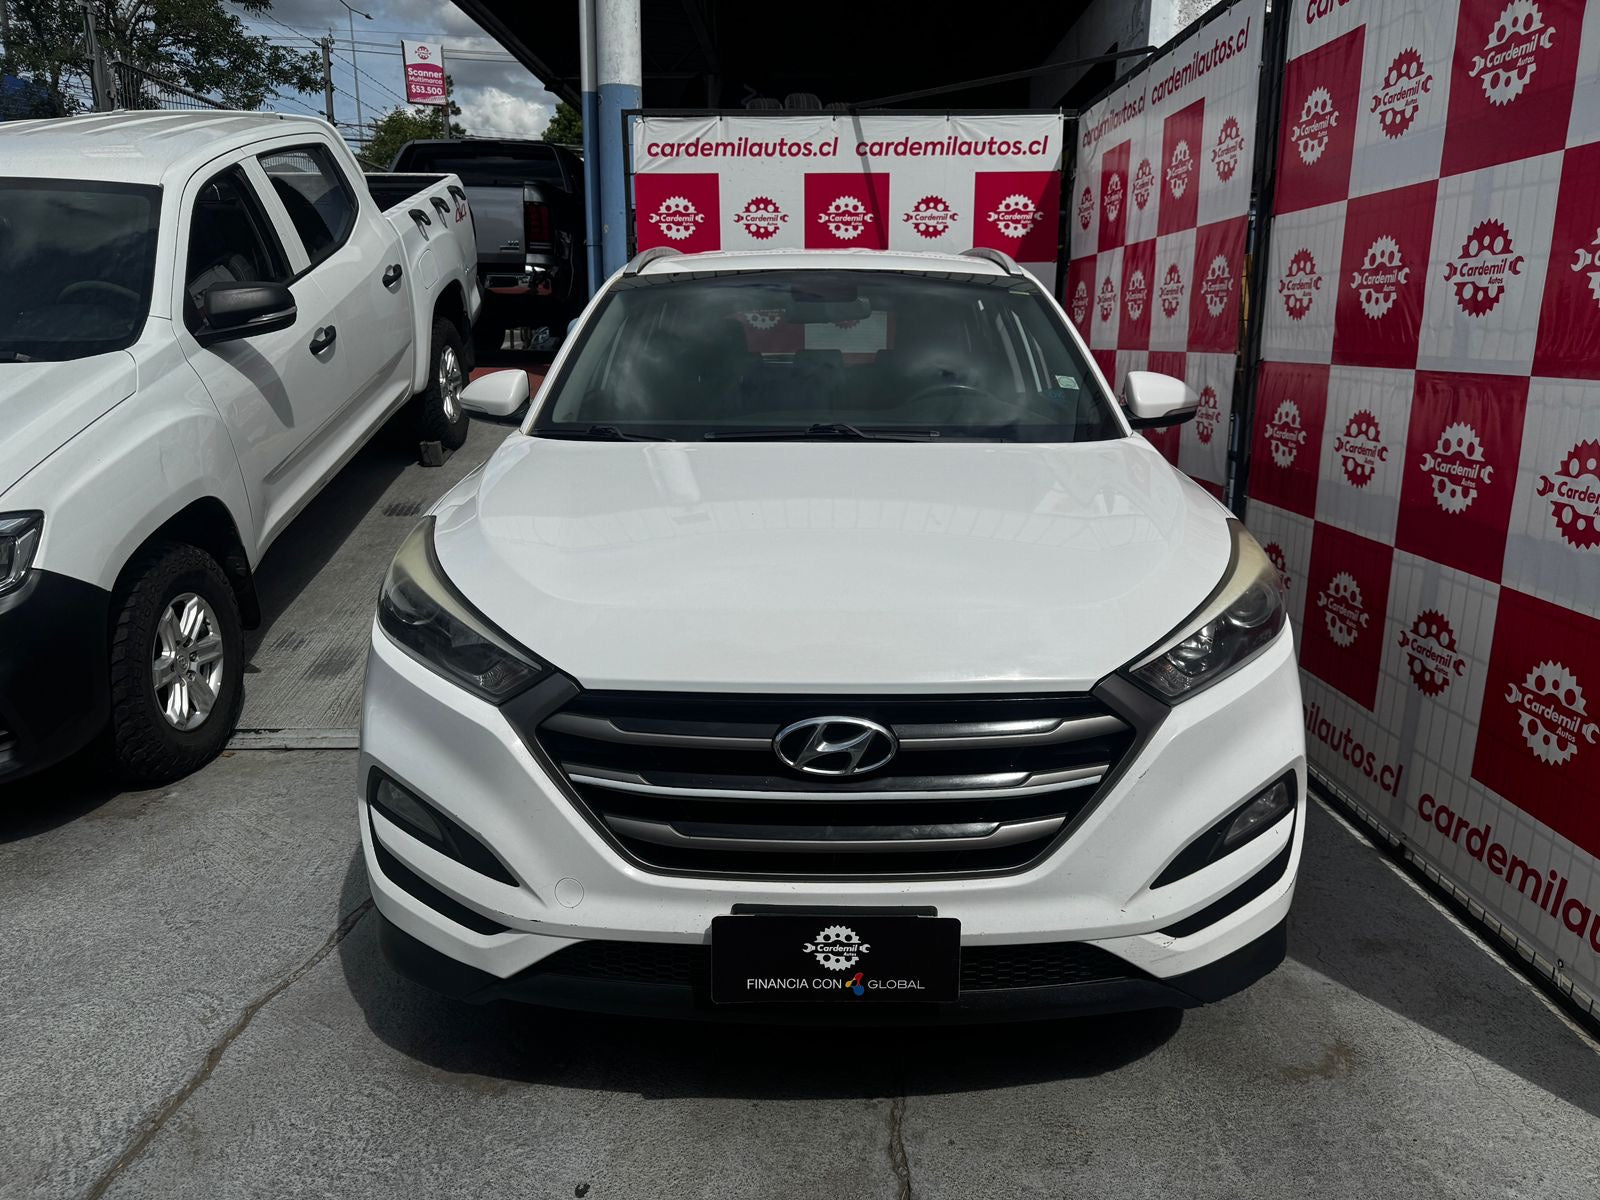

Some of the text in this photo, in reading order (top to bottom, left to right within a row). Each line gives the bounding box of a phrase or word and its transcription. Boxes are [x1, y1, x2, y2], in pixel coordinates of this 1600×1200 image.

[1486, 33, 1539, 68] Cardemil
[1151, 16, 1251, 105] cardemilautos.cl
[1516, 55, 1535, 67] Autos
[408, 68, 442, 78] Scanner
[411, 84, 443, 95] $53.500
[1383, 80, 1420, 106] Cardemil
[1300, 115, 1330, 136] Cardemil
[647, 135, 1049, 158] cardemilautos.cl cardemilautos.cl
[660, 213, 695, 222] Cardemil
[745, 213, 779, 222] Cardemil
[829, 213, 863, 222] Cardemil
[914, 213, 949, 221] Cardemil
[999, 211, 1034, 220] Cardemil
[1459, 257, 1508, 278] Cardemil
[1362, 269, 1398, 286] Cardemil
[1488, 277, 1504, 285] Autos
[1344, 441, 1378, 459] Cardemil
[1434, 457, 1481, 480] Cardemil
[1460, 477, 1476, 489] Autos
[1327, 598, 1361, 621] Cardemil
[1411, 638, 1453, 669] Cardemil
[1523, 694, 1581, 733] Cardemil
[1556, 727, 1576, 743] Autos
[817, 944, 858, 952] Cardemil
[746, 977, 926, 990] FINANCIA CON GLOBAL
